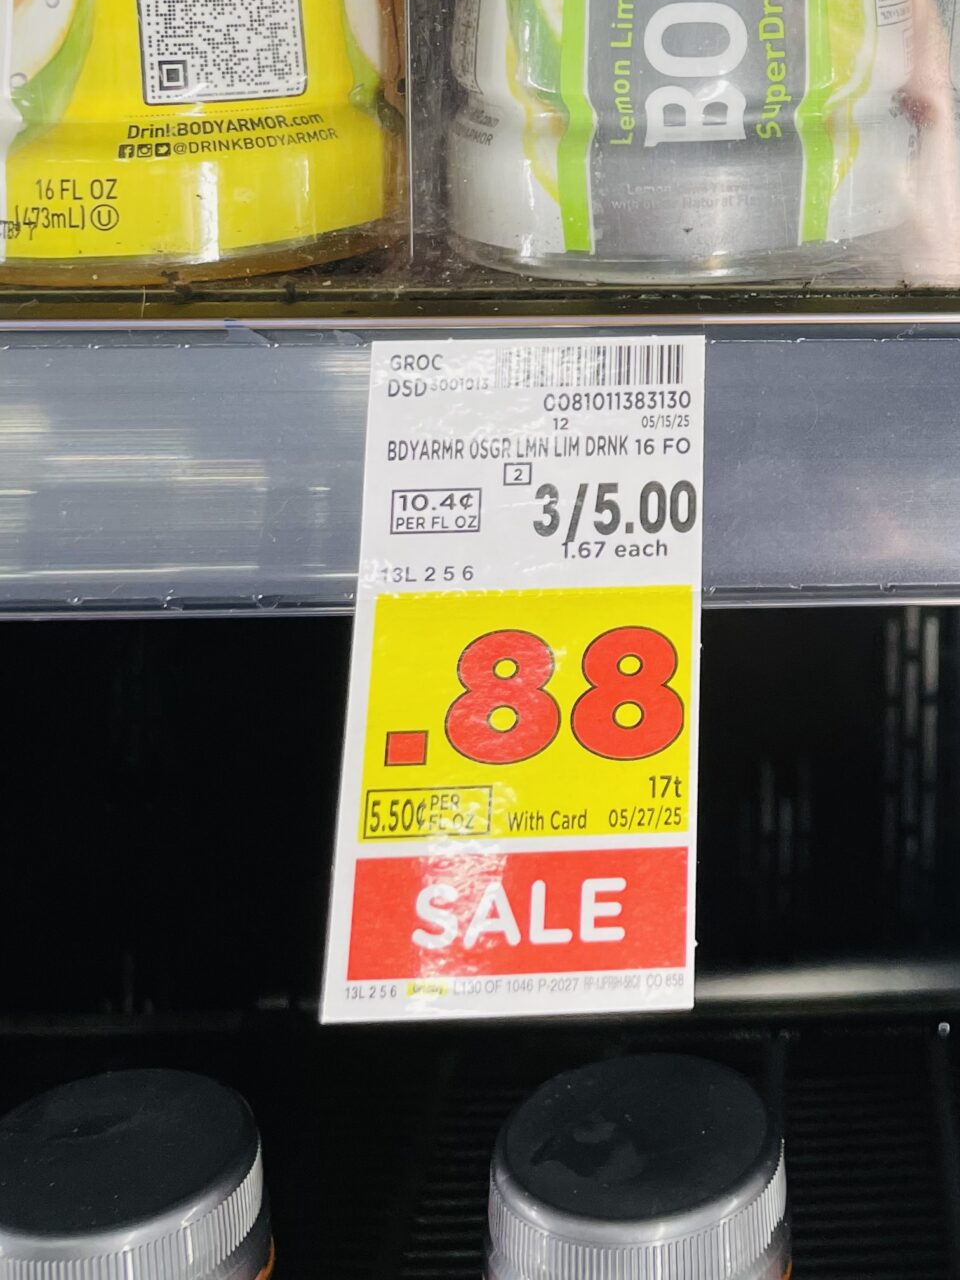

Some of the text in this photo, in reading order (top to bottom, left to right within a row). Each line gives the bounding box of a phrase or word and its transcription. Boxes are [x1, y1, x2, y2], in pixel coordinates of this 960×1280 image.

[610, 61, 635, 145] Lemon
[127, 114, 323, 140] DrinkBODYARMOR.com
[173, 128, 338, 155] @DRINKBODYARMOR
[36, 179, 117, 200] 16 FL OZ
[15, 204, 85, 231] (473mL)
[390, 354, 444, 371] GROC
[387, 379, 427, 397] DSD
[553, 414, 690, 430] 12 05/15/25
[387, 438, 464, 461] BDYARMR
[516, 436, 548, 458] LMN
[554, 436, 580, 458] LIM
[586, 435, 628, 456] DRNK
[635, 438, 655, 455] 16
[663, 437, 691, 455] FO
[514, 469, 523, 481] 2
[399, 492, 474, 512] 10.4¢
[533, 480, 697, 543] 3/5.00
[396, 515, 477, 530] PER FL OZ
[561, 539, 668, 560] 1.67 each
[381, 565, 474, 583] 13L 2 5 6
[384, 625, 685, 767] .88
[649, 775, 682, 800] 17t
[369, 794, 460, 833] 5.50¢ PER
[429, 814, 447, 832] FL
[508, 806, 682, 832] With Card 05/27/25
[411, 877, 628, 951] SALE
[345, 987, 366, 1000] 13L
[485, 979, 502, 994] OF
